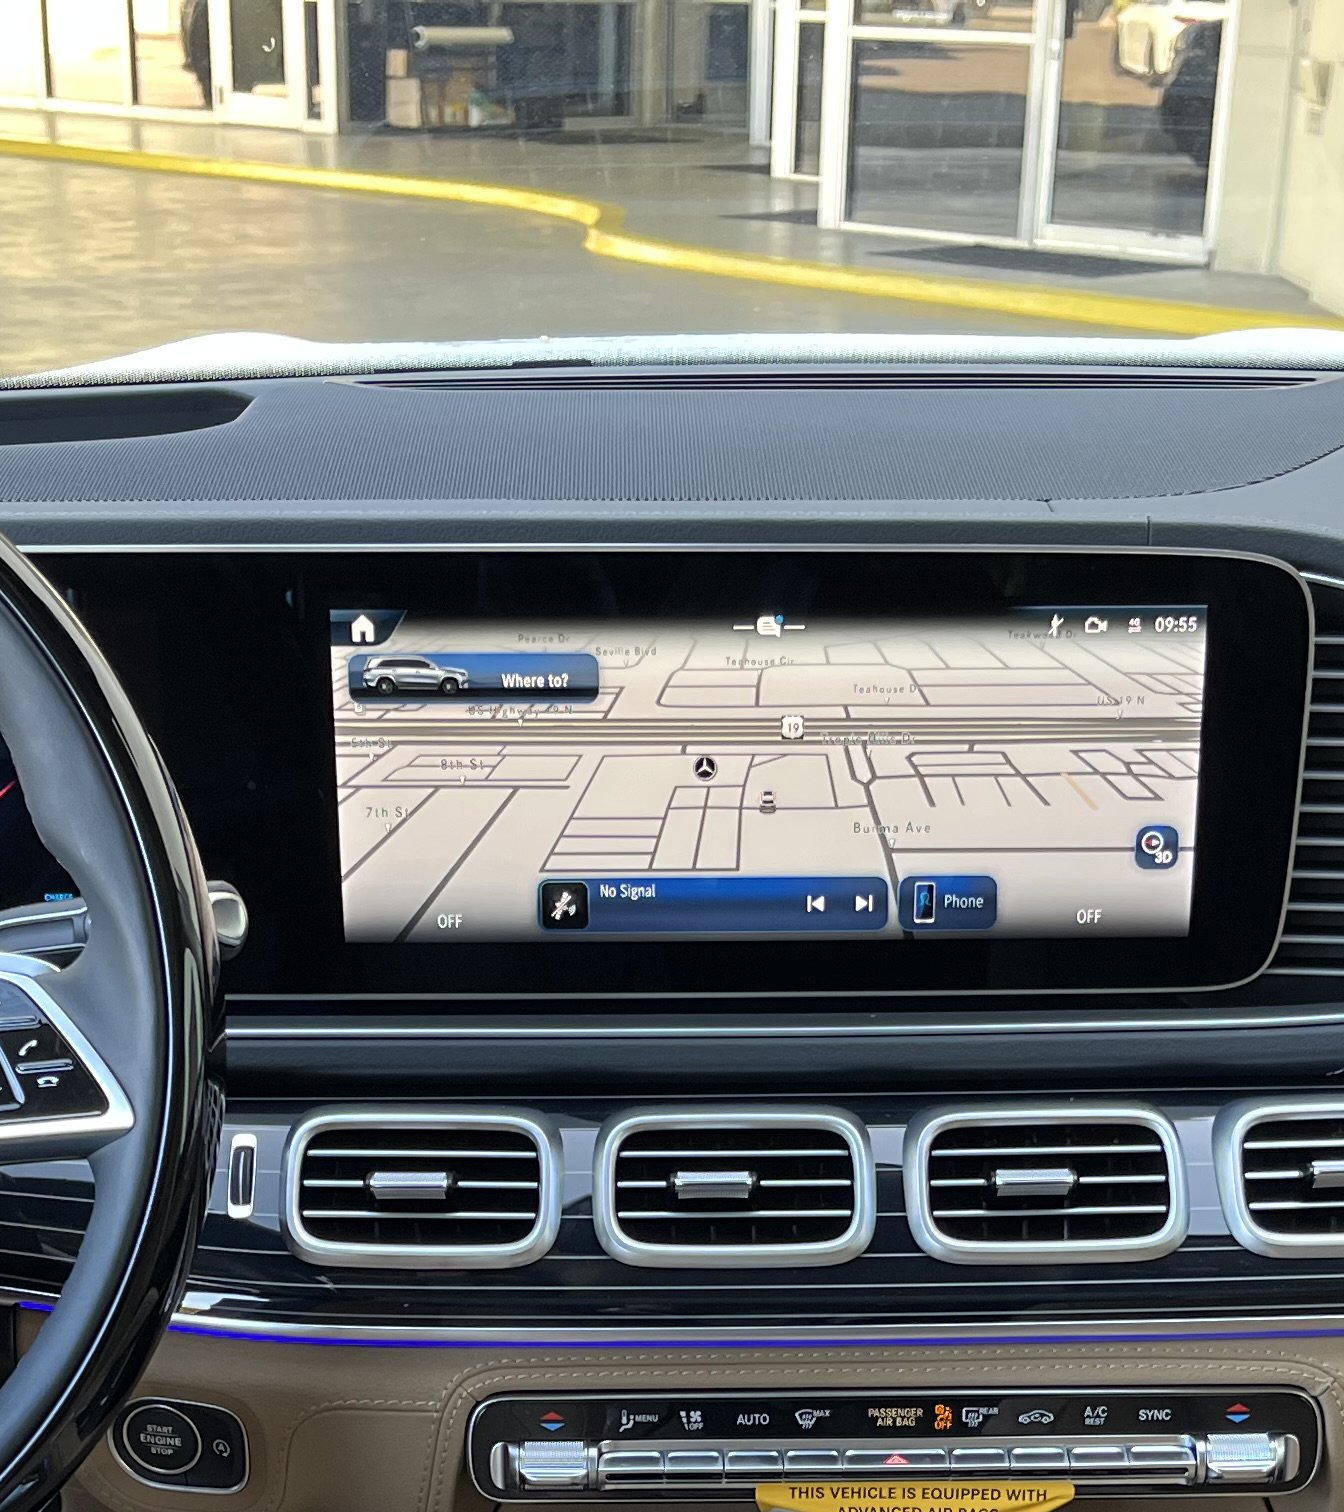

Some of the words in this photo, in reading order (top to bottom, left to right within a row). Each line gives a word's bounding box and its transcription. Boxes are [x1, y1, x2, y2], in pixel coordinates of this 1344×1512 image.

[1155, 616, 1197, 633] 09:55
[634, 647, 657, 657] Blvd
[501, 674, 545, 688] Where
[548, 674, 569, 688] to?
[787, 723, 799, 733] 19
[440, 759, 463, 770] 8th
[470, 759, 484, 770] St
[366, 806, 389, 818] 7th
[394, 806, 409, 818] St
[905, 822, 931, 834] Ave
[1155, 852, 1172, 864] 3D
[599, 885, 616, 898] No
[620, 884, 656, 900] Signal
[943, 894, 984, 909] Phone
[437, 914, 463, 928] OFF
[1076, 909, 1102, 924] OFF
[813, 1409, 831, 1418] MAX
[868, 1407, 923, 1418] PASSENGER
[979, 1407, 999, 1415] REAR
[1084, 1406, 1108, 1417] A/C
[1138, 1409, 1171, 1420] SYNC
[635, 1414, 659, 1423] MENU
[736, 1414, 770, 1426] AUTO
[877, 1418, 893, 1427] AIR
[896, 1418, 916, 1427] BAG
[147, 1424, 173, 1434] START
[689, 1422, 703, 1431] OFF
[140, 1433, 182, 1447] ENGINE
[151, 1446, 174, 1456] STOP
[789, 1487, 825, 1499] THIS
[829, 1487, 896, 1499] VEHICLE
[902, 1487, 916, 1499] IS
[921, 1488, 1001, 1501] EQUIPPED
[1006, 1489, 1047, 1501] WITH
